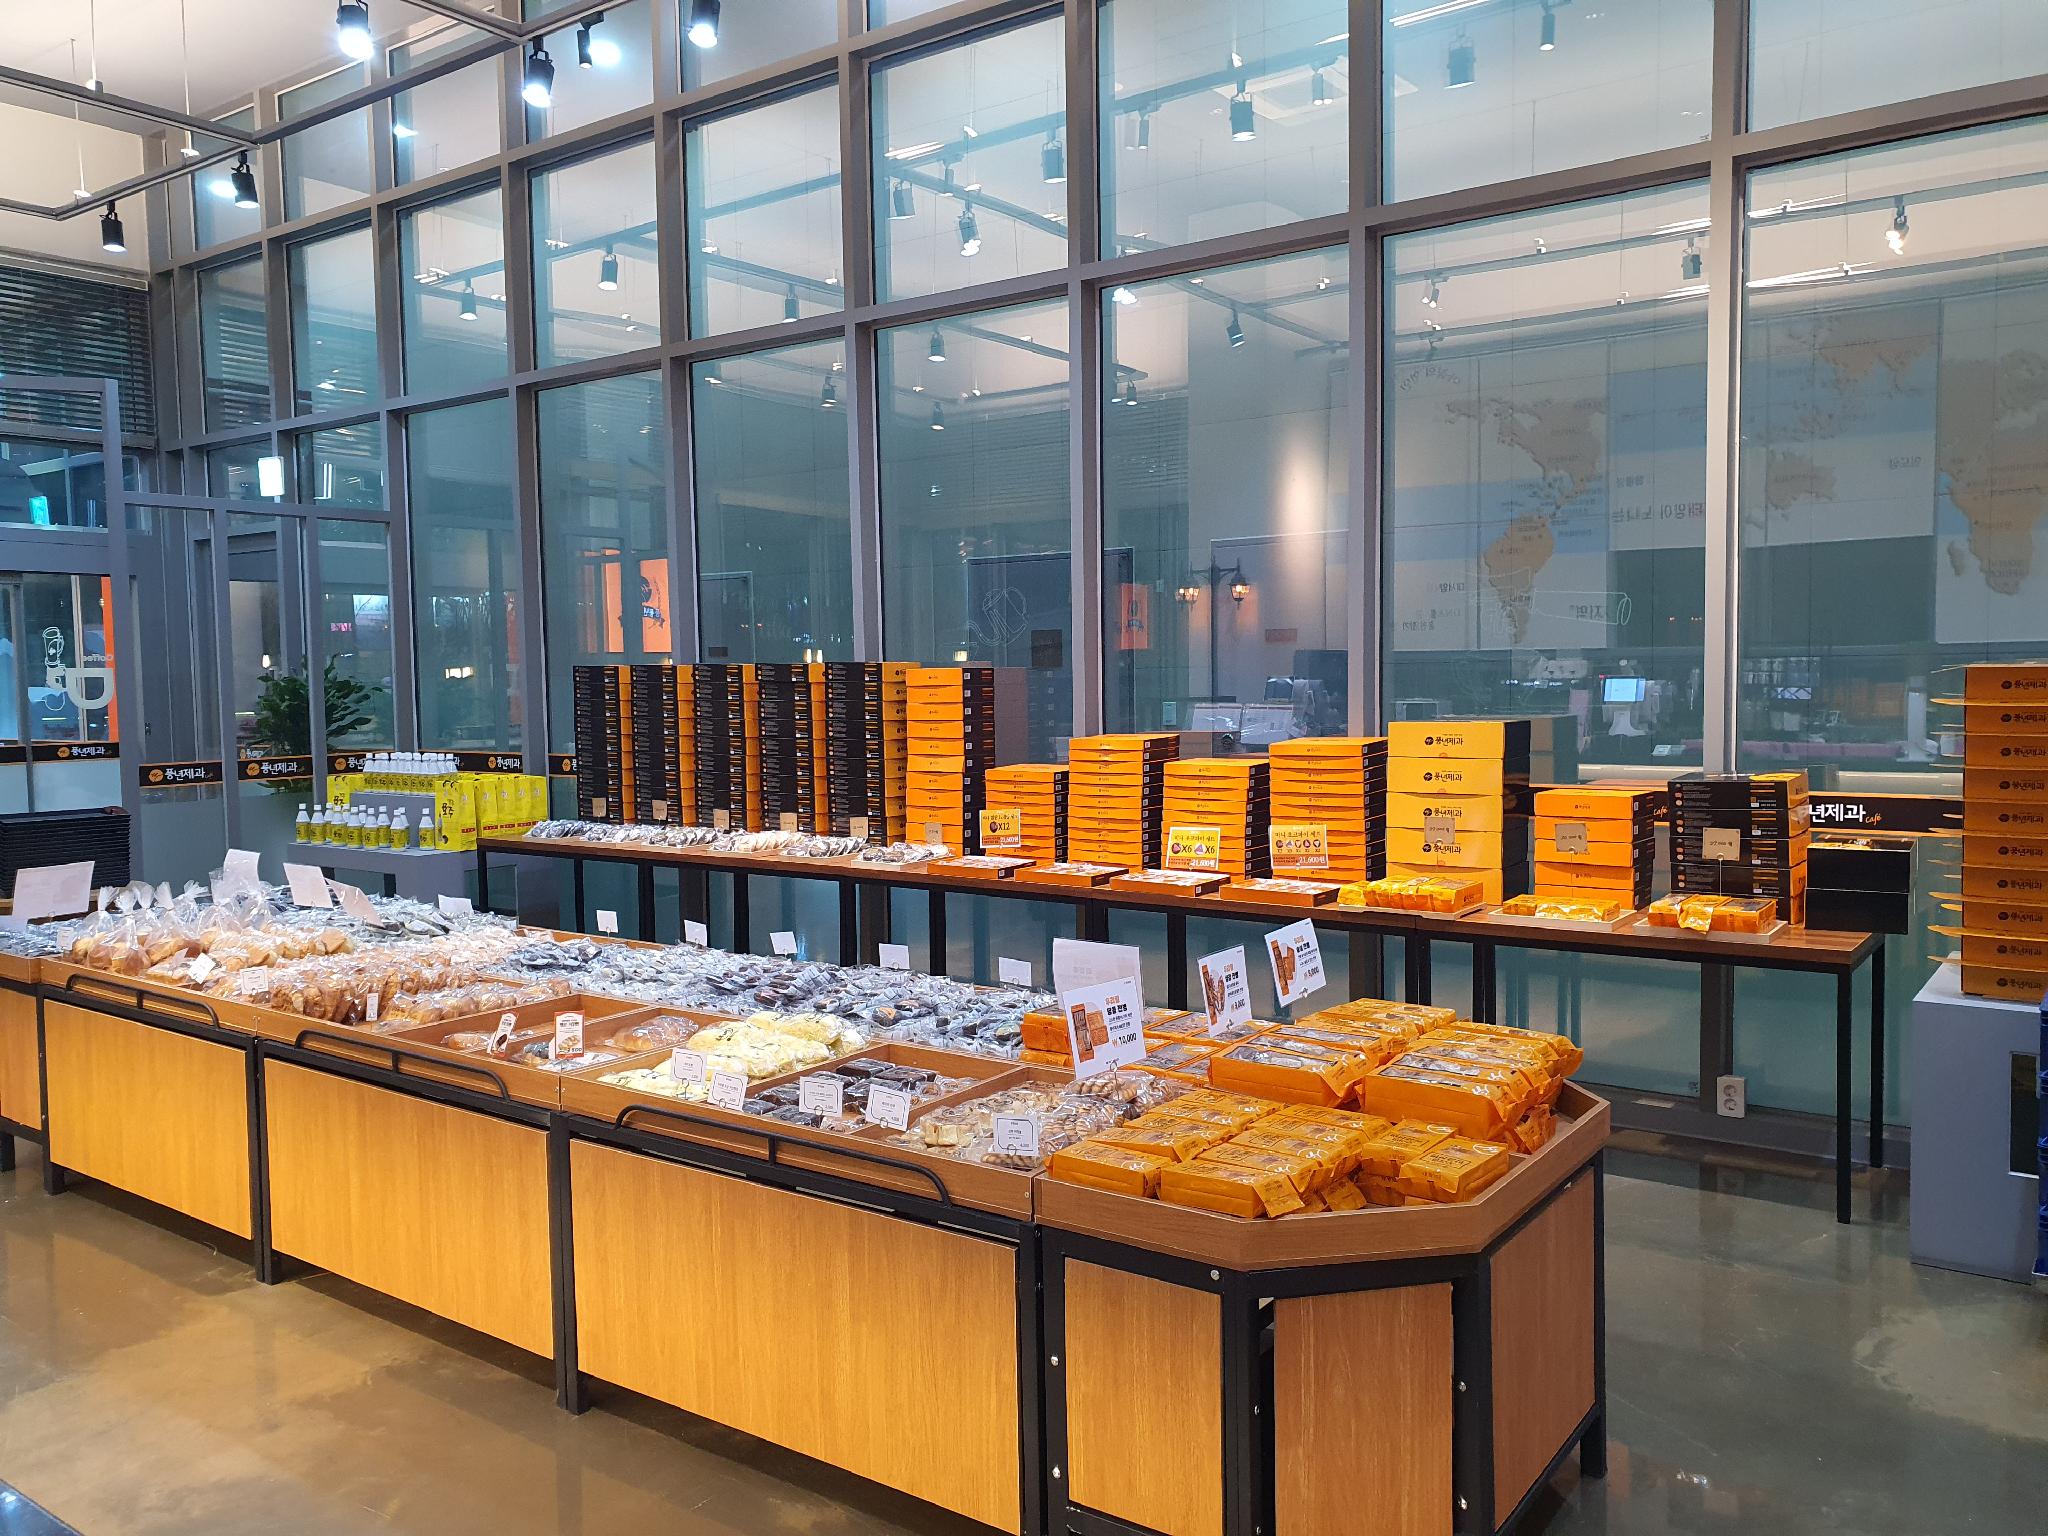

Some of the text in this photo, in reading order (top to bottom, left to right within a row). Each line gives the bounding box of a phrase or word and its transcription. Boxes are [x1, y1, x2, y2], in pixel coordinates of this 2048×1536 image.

[1435, 736, 1463, 746] 풍년제과
[71, 746, 105, 757] 풍년제과
[497, 756, 521, 770] 풍년제과
[261, 762, 298, 775] 풍년제과
[165, 767, 206, 781] 풍년제과
[1434, 772, 1462, 782] 풍년제과
[441, 802, 455, 818] 모주
[1433, 808, 1462, 818] 풍년제과
[1809, 804, 1866, 823] 년제과
[998, 822, 1010, 831] X12
[1182, 844, 1192, 854] X6
[1205, 845, 1215, 854] X6
[1433, 843, 1461, 854] 풍년제과
[1191, 859, 1215, 867] 21,600원
